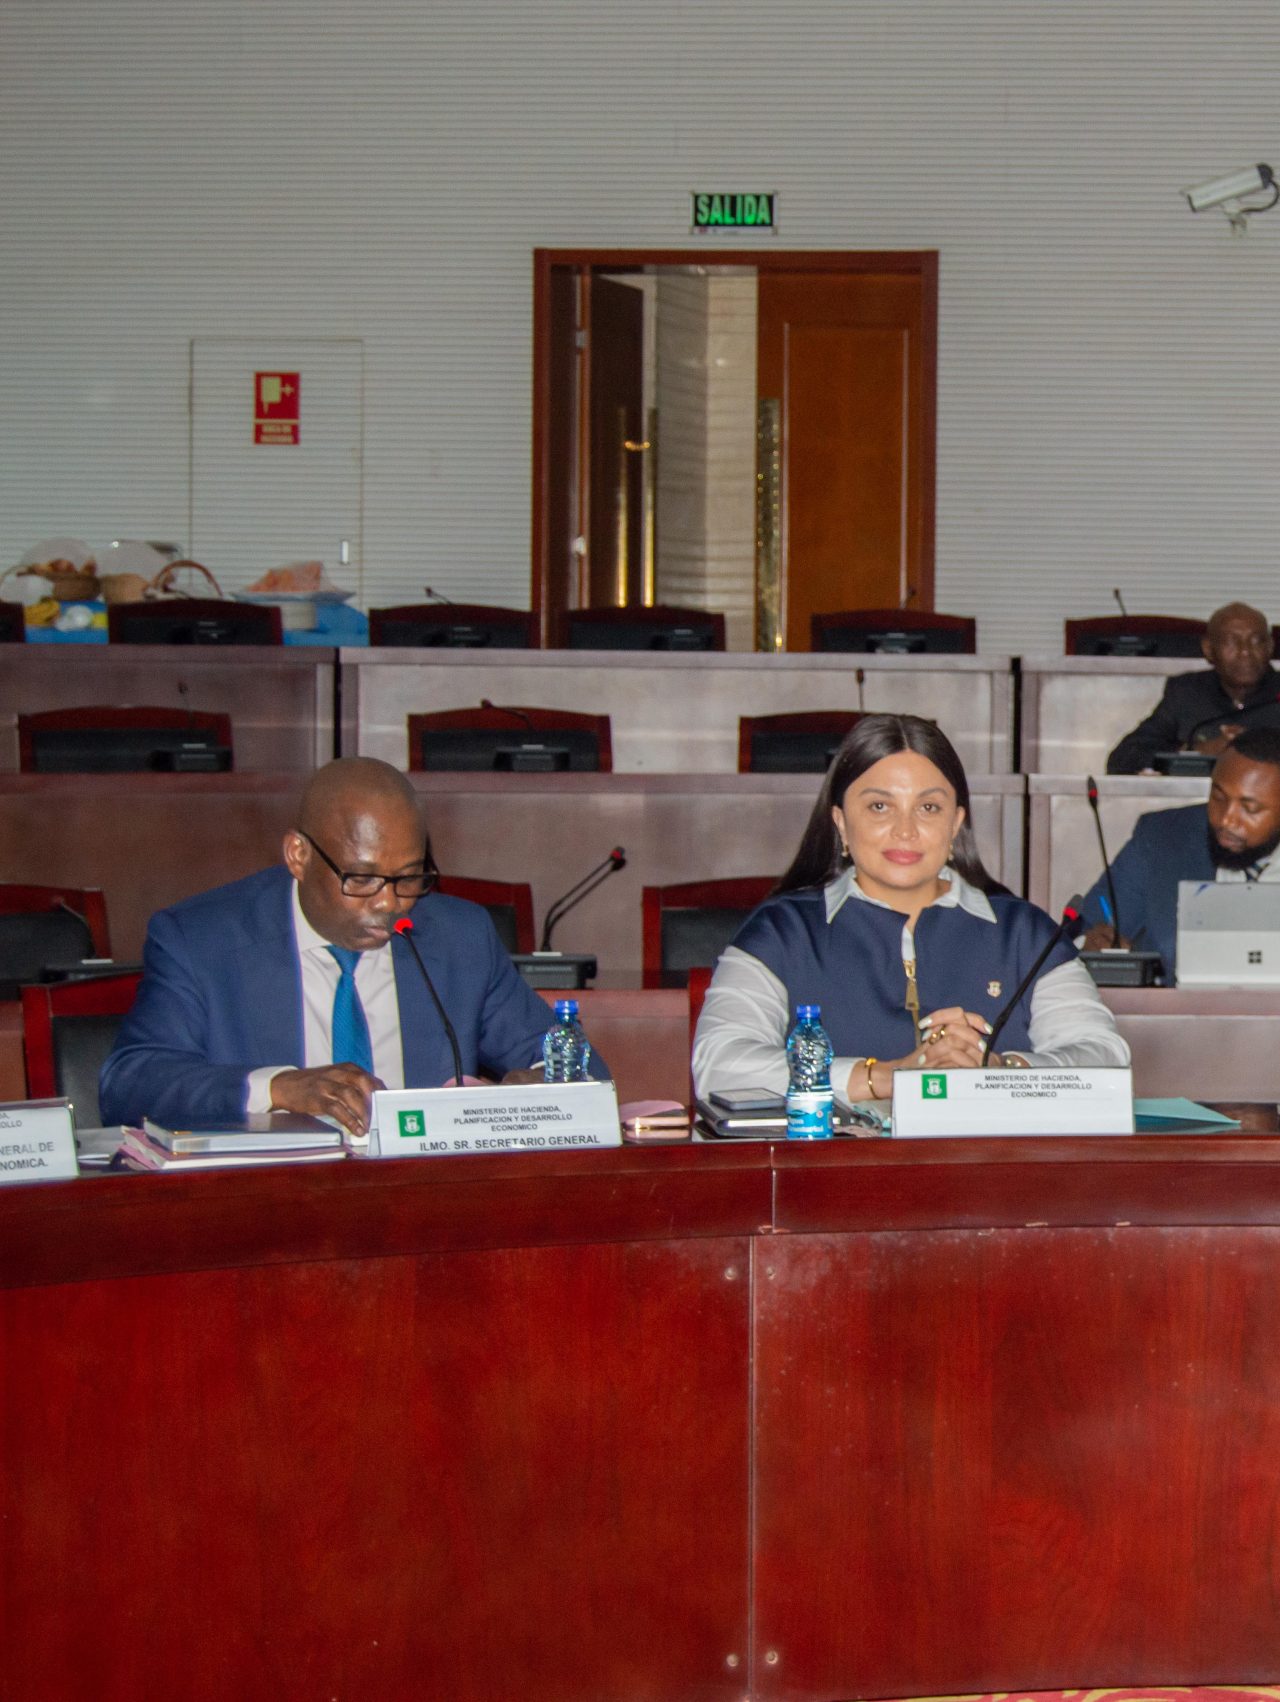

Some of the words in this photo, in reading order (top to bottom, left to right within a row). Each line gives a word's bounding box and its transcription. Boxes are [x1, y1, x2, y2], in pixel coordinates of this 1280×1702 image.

[697, 193, 771, 225] SALIDA
[463, 1107, 506, 1115] MINISTERIO
[453, 1116, 512, 1125] PLANIFICACION
[521, 1113, 572, 1121] DESARROLLO
[491, 1123, 538, 1132] ECONOMICO
[38, 1141, 55, 1152] DE
[419, 1141, 450, 1151] ILMO.
[453, 1140, 472, 1150] SR.
[475, 1137, 545, 1149] SECRETARIO
[549, 1134, 600, 1146] GENERAL
